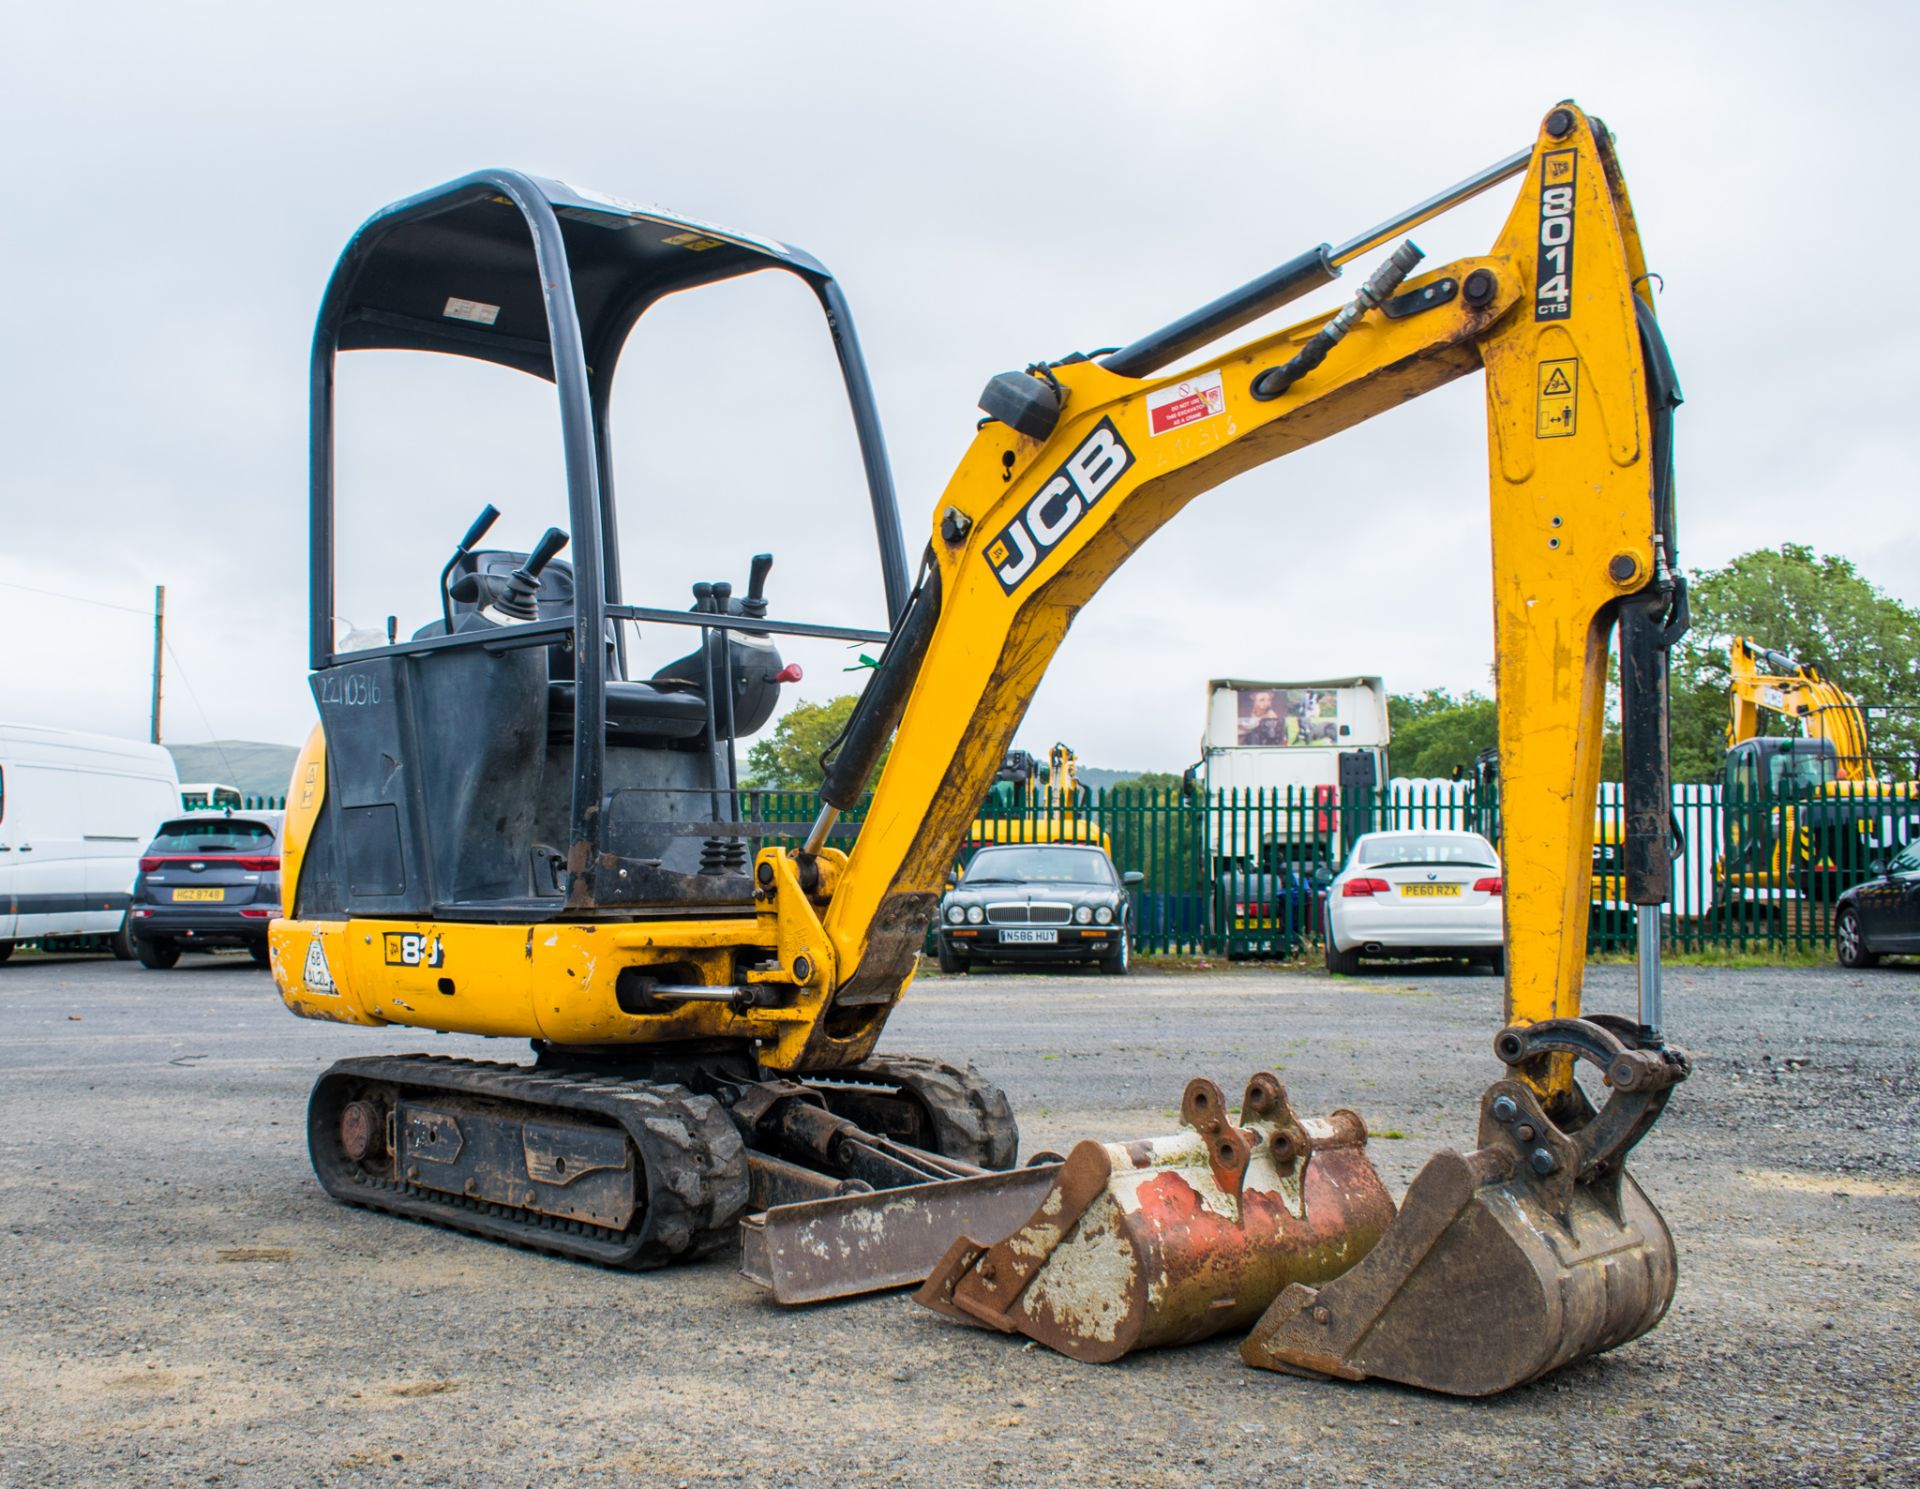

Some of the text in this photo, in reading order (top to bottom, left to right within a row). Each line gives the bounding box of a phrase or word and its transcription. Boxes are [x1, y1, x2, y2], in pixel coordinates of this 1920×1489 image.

[1538, 187, 1573, 302] 8014
[1538, 303, 1568, 315] CTS
[1177, 404, 1205, 416] EXCAVATO
[1180, 401, 1189, 409] NOT
[999, 428, 1127, 585] JCB
[1406, 885, 1458, 896] PE60 RZX
[1007, 931, 1056, 941] N586 HUY
